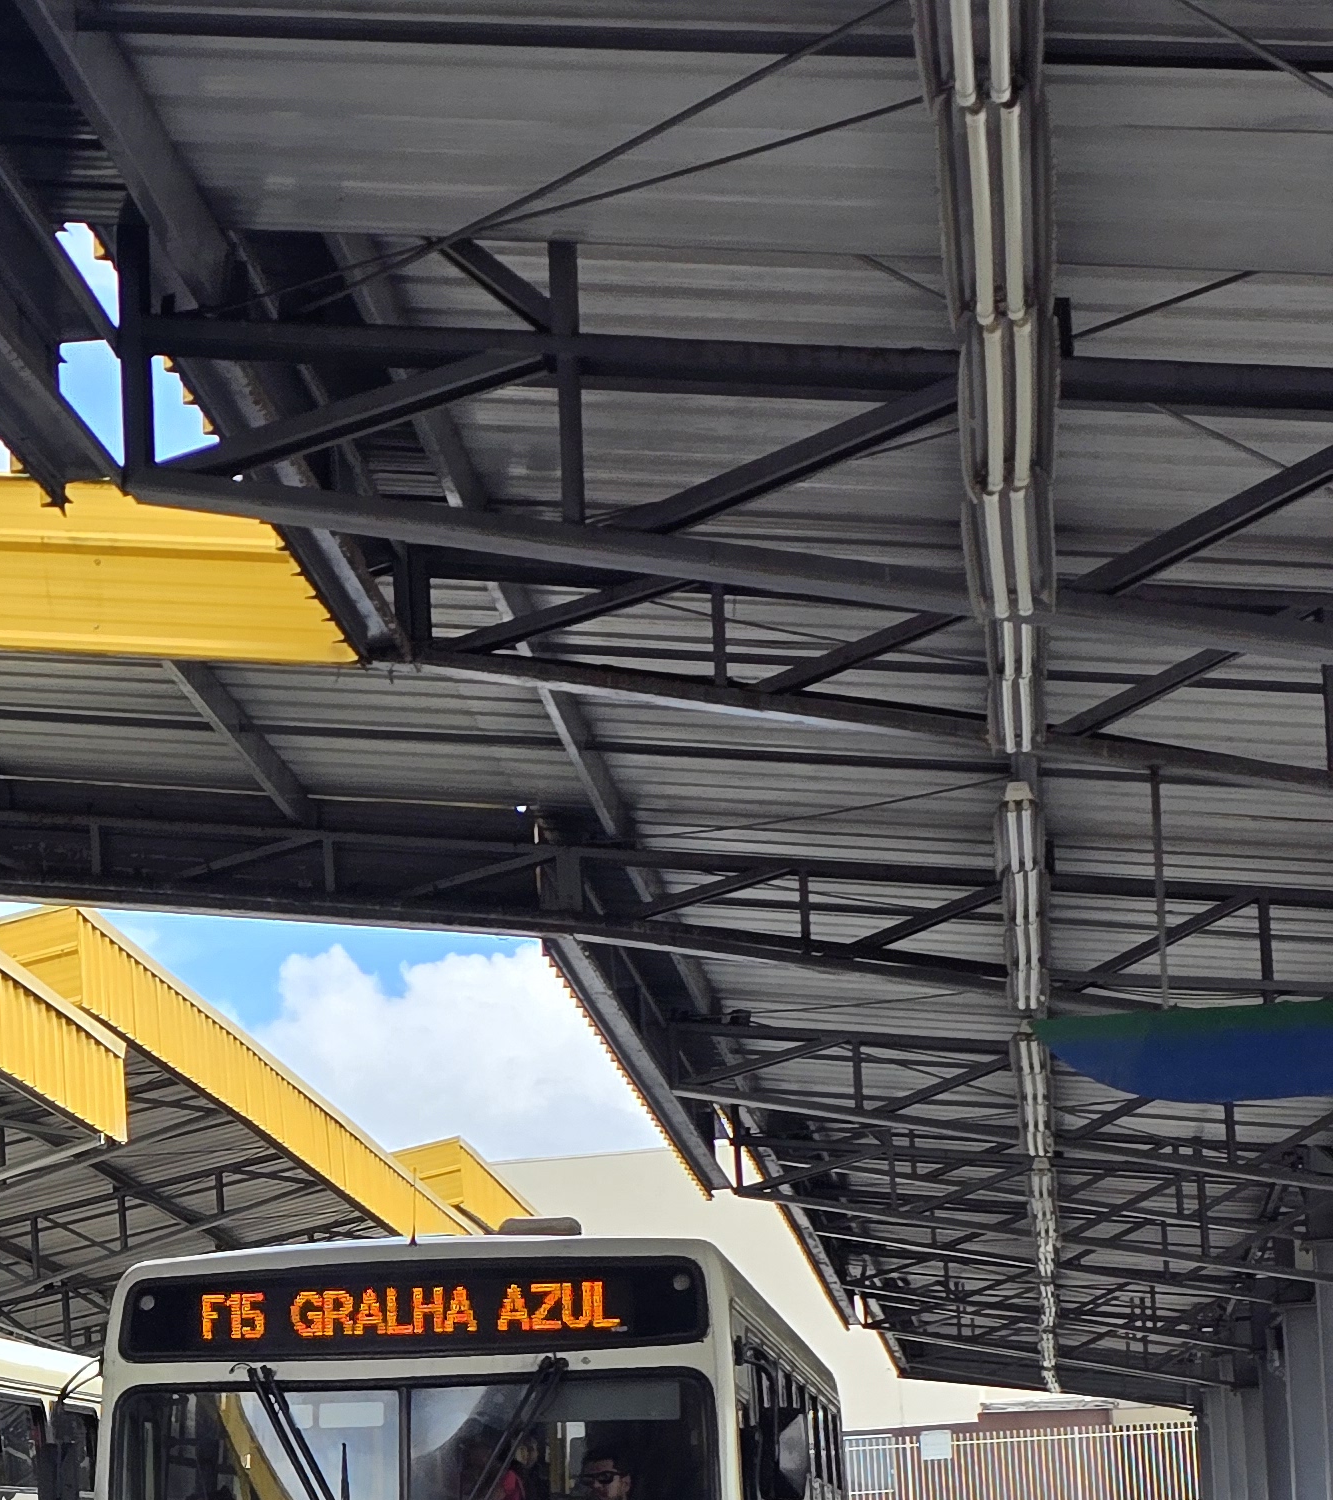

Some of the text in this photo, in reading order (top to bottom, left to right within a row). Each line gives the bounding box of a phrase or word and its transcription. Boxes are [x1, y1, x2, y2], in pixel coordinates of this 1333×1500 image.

[201, 1281, 621, 1340] F15 GRALHA AZUL
